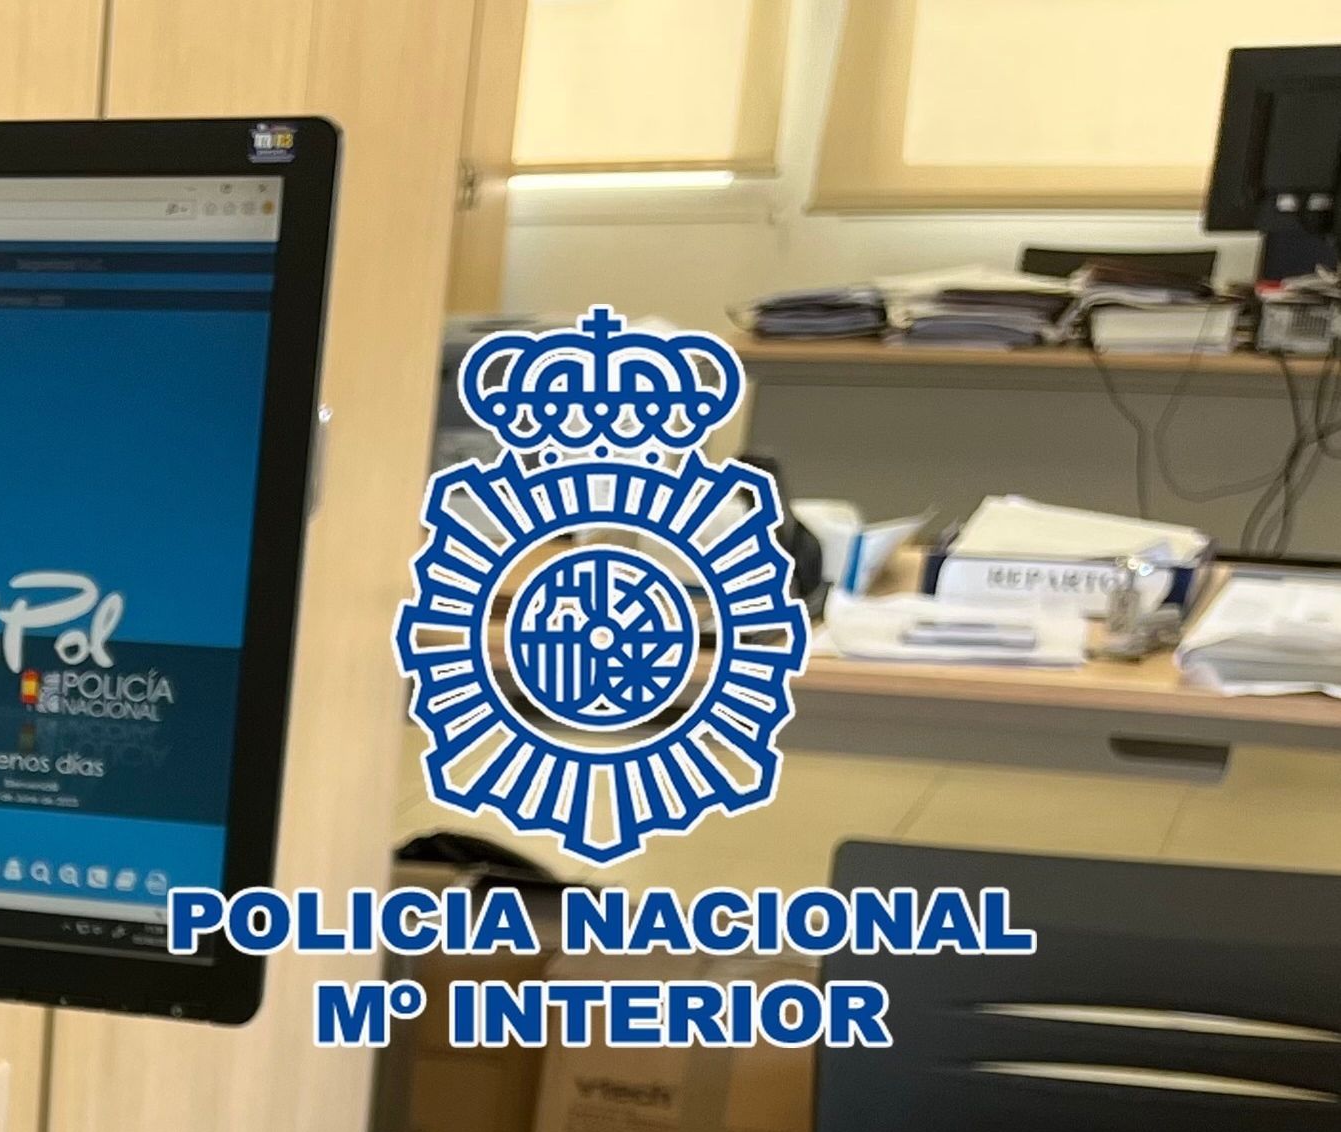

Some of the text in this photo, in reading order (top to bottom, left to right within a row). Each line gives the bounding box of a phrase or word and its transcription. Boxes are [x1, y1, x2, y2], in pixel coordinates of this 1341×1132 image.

[61, 667, 175, 704] POLICÍA
[61, 697, 162, 722] NACIONAL
[54, 752, 107, 778] días
